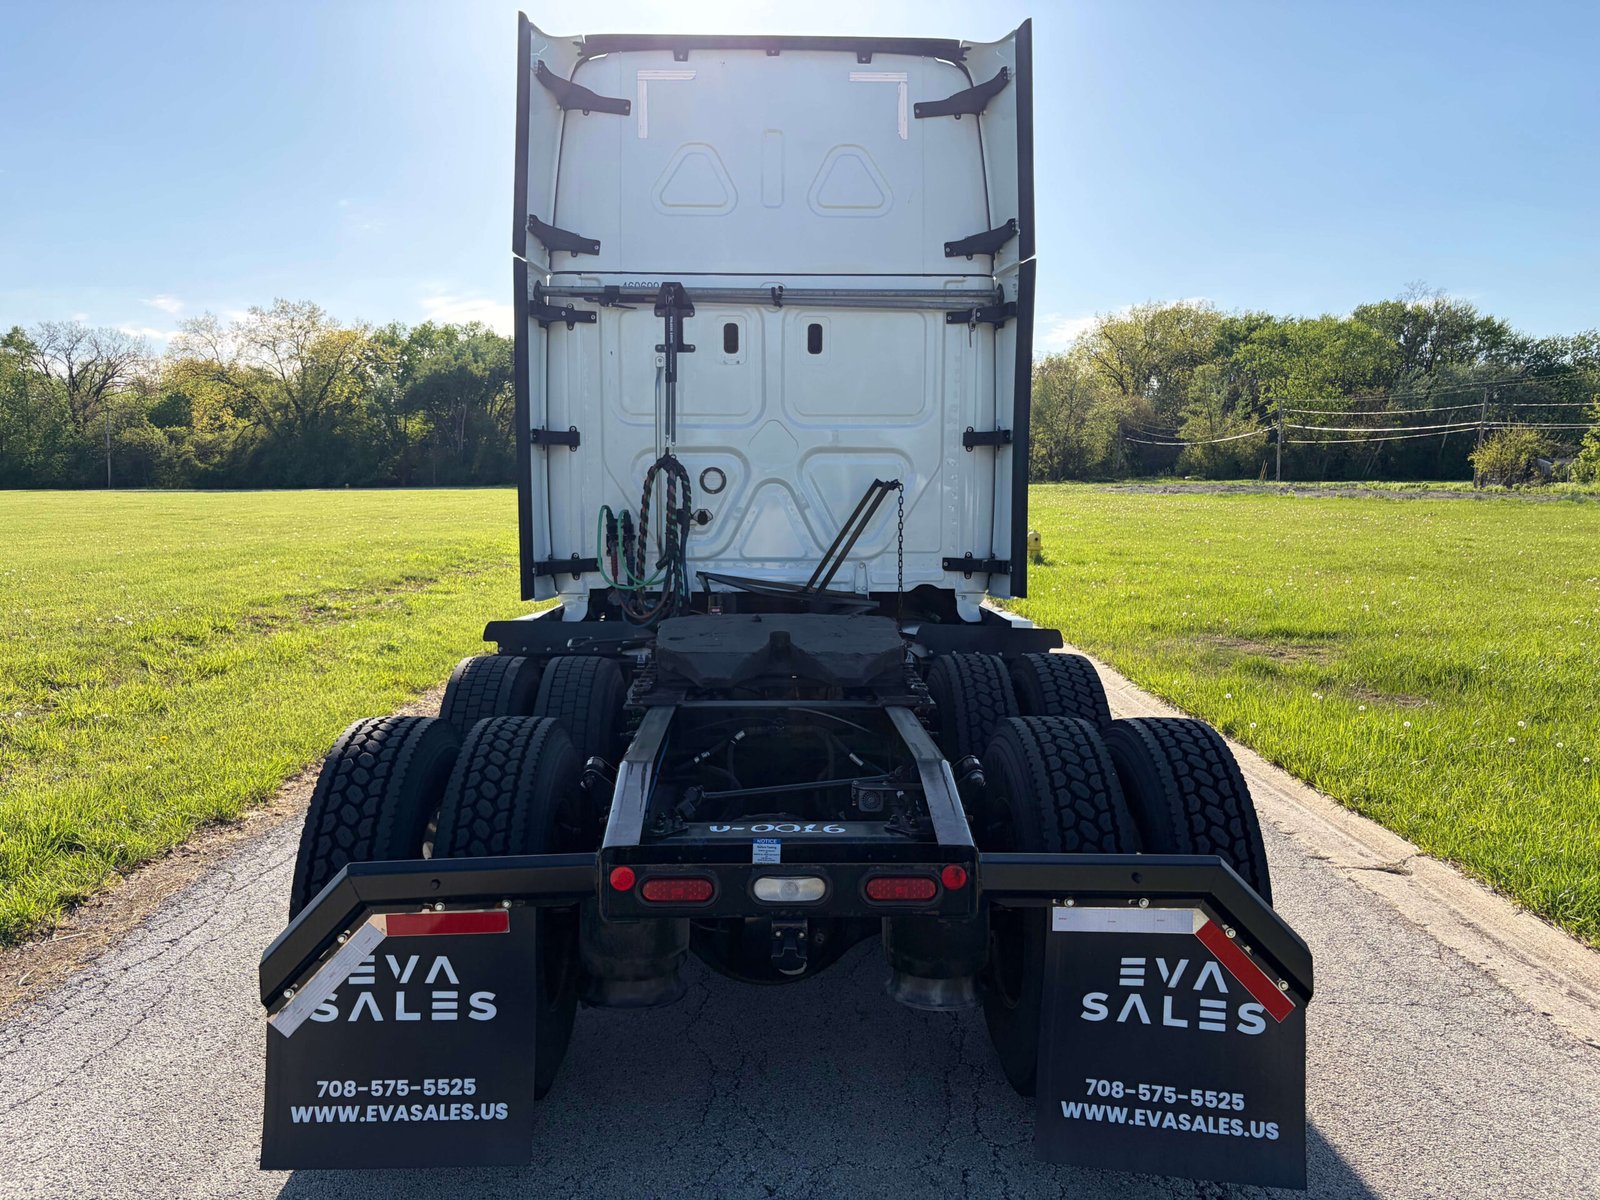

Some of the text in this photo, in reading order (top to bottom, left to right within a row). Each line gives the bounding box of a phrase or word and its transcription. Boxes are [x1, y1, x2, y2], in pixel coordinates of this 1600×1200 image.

[348, 955, 460, 984] EVA
[1119, 957, 1229, 994] EVA
[309, 991, 497, 1022] SALES
[1080, 992, 1267, 1035] SALES
[316, 1078, 477, 1098] 708-575-5525
[1085, 1078, 1245, 1111] 708-575-5525
[290, 1103, 509, 1123] WWW.EVASALES.US
[1061, 1101, 1280, 1141] WWW.EVASALES.US
